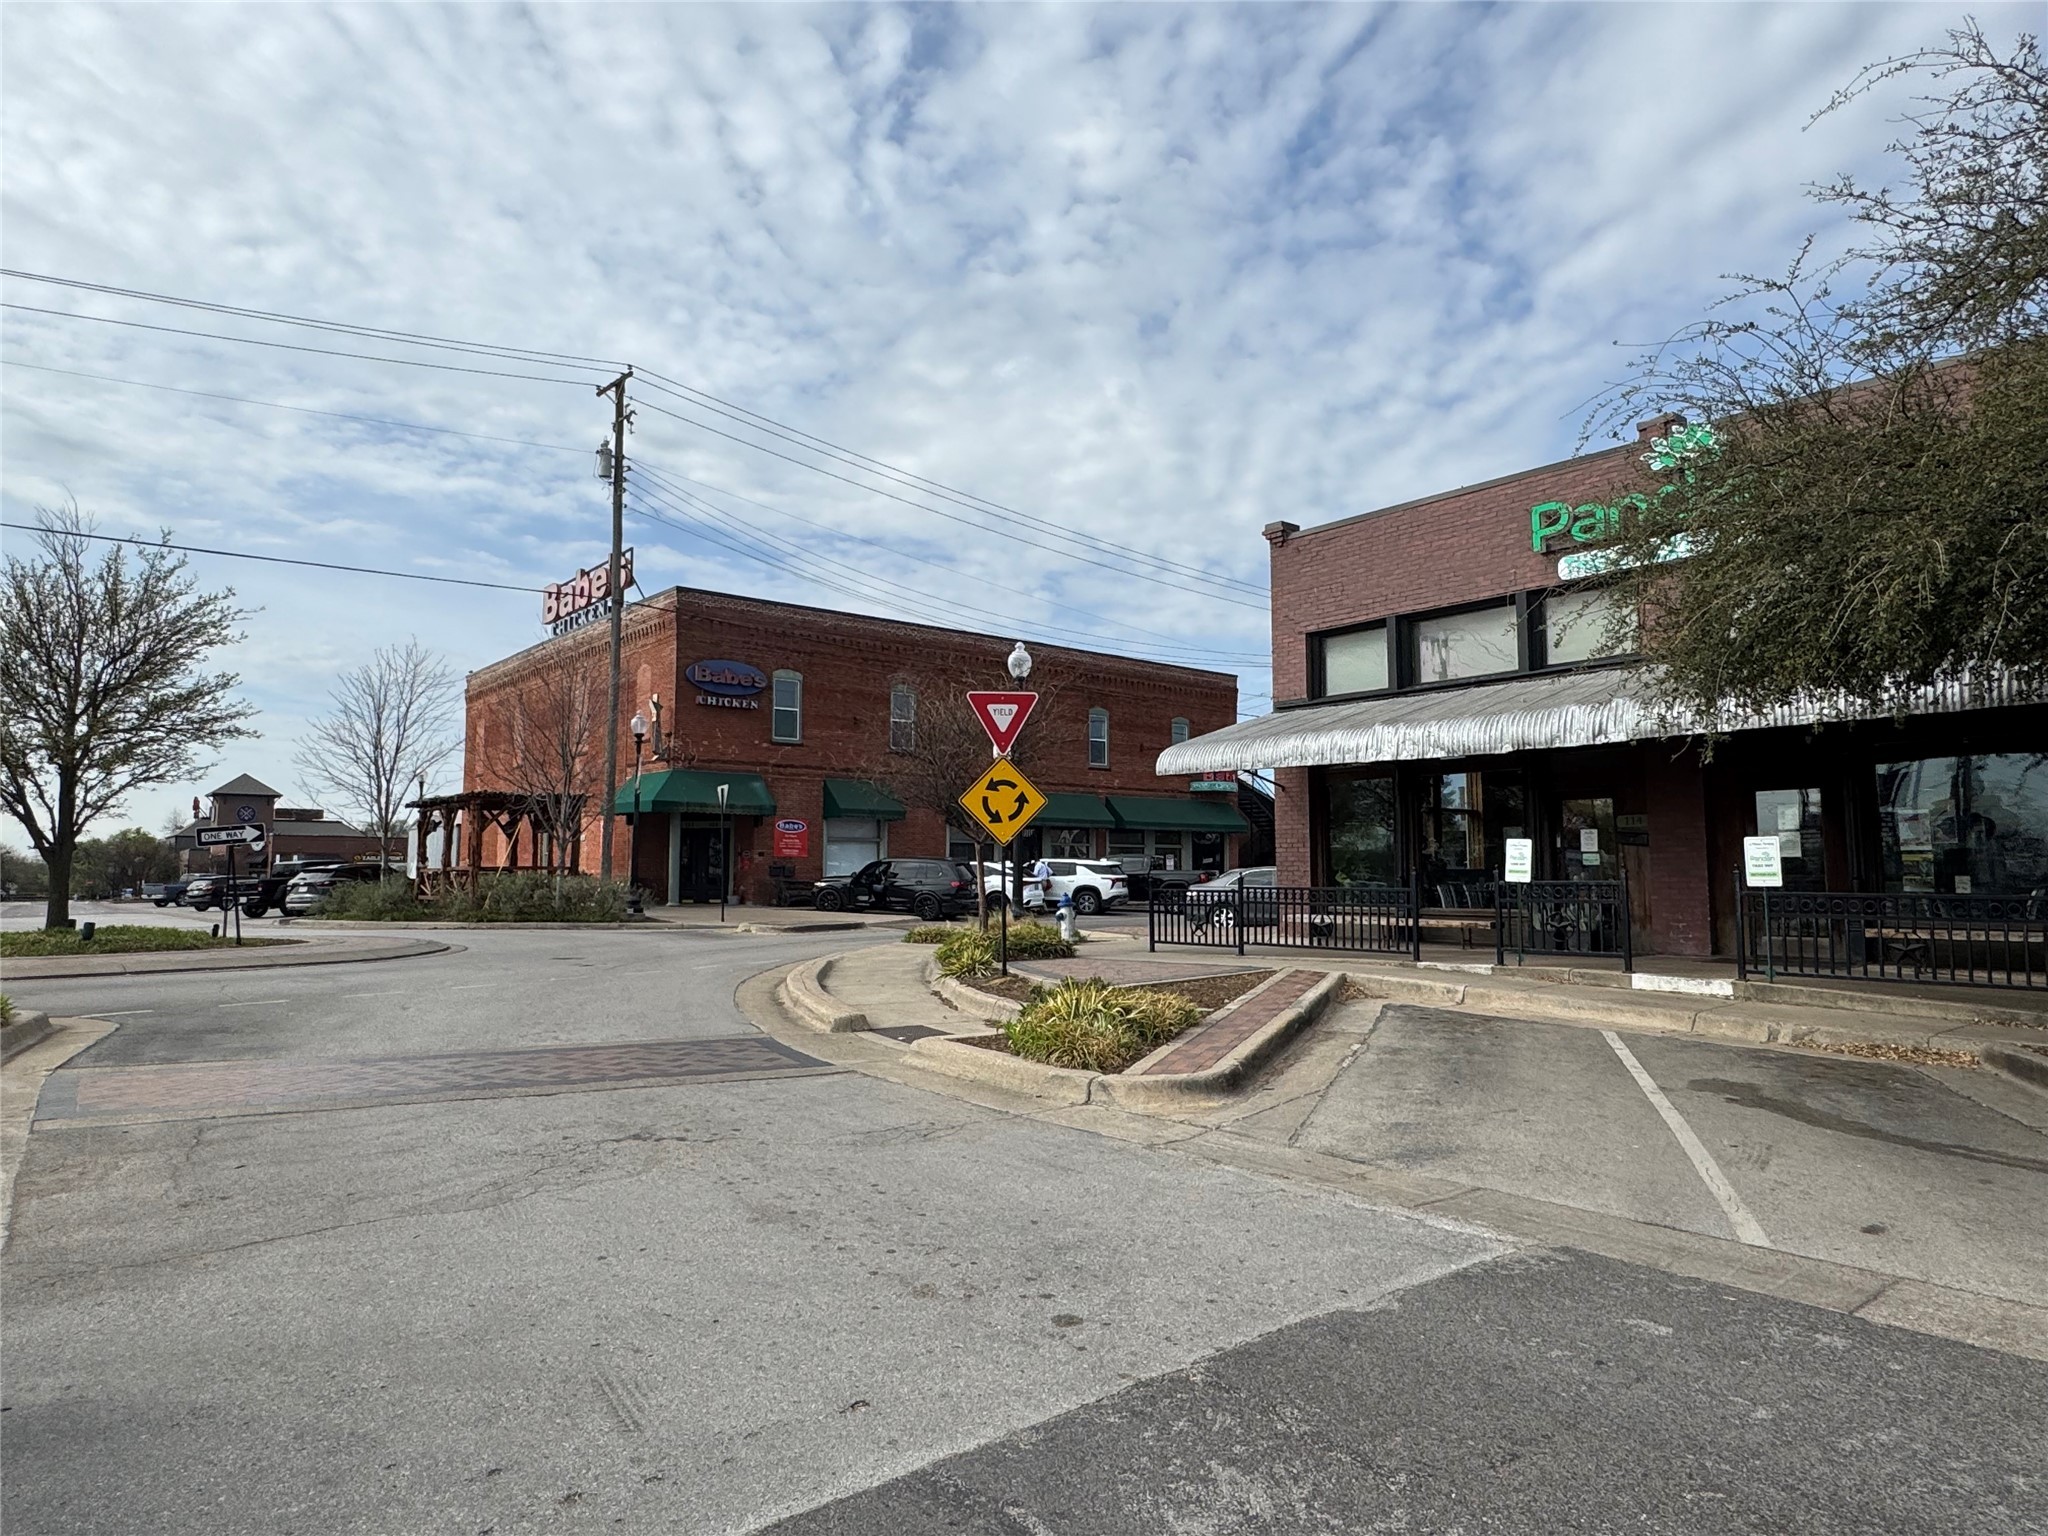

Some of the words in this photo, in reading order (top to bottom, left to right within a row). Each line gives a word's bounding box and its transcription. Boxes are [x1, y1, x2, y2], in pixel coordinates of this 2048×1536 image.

[694, 664, 767, 688] Babe's
[696, 695, 759, 710] CHICKEN
[992, 708, 1013, 716] YIELD
[203, 831, 222, 841] ONE
[225, 830, 245, 839] WAY
